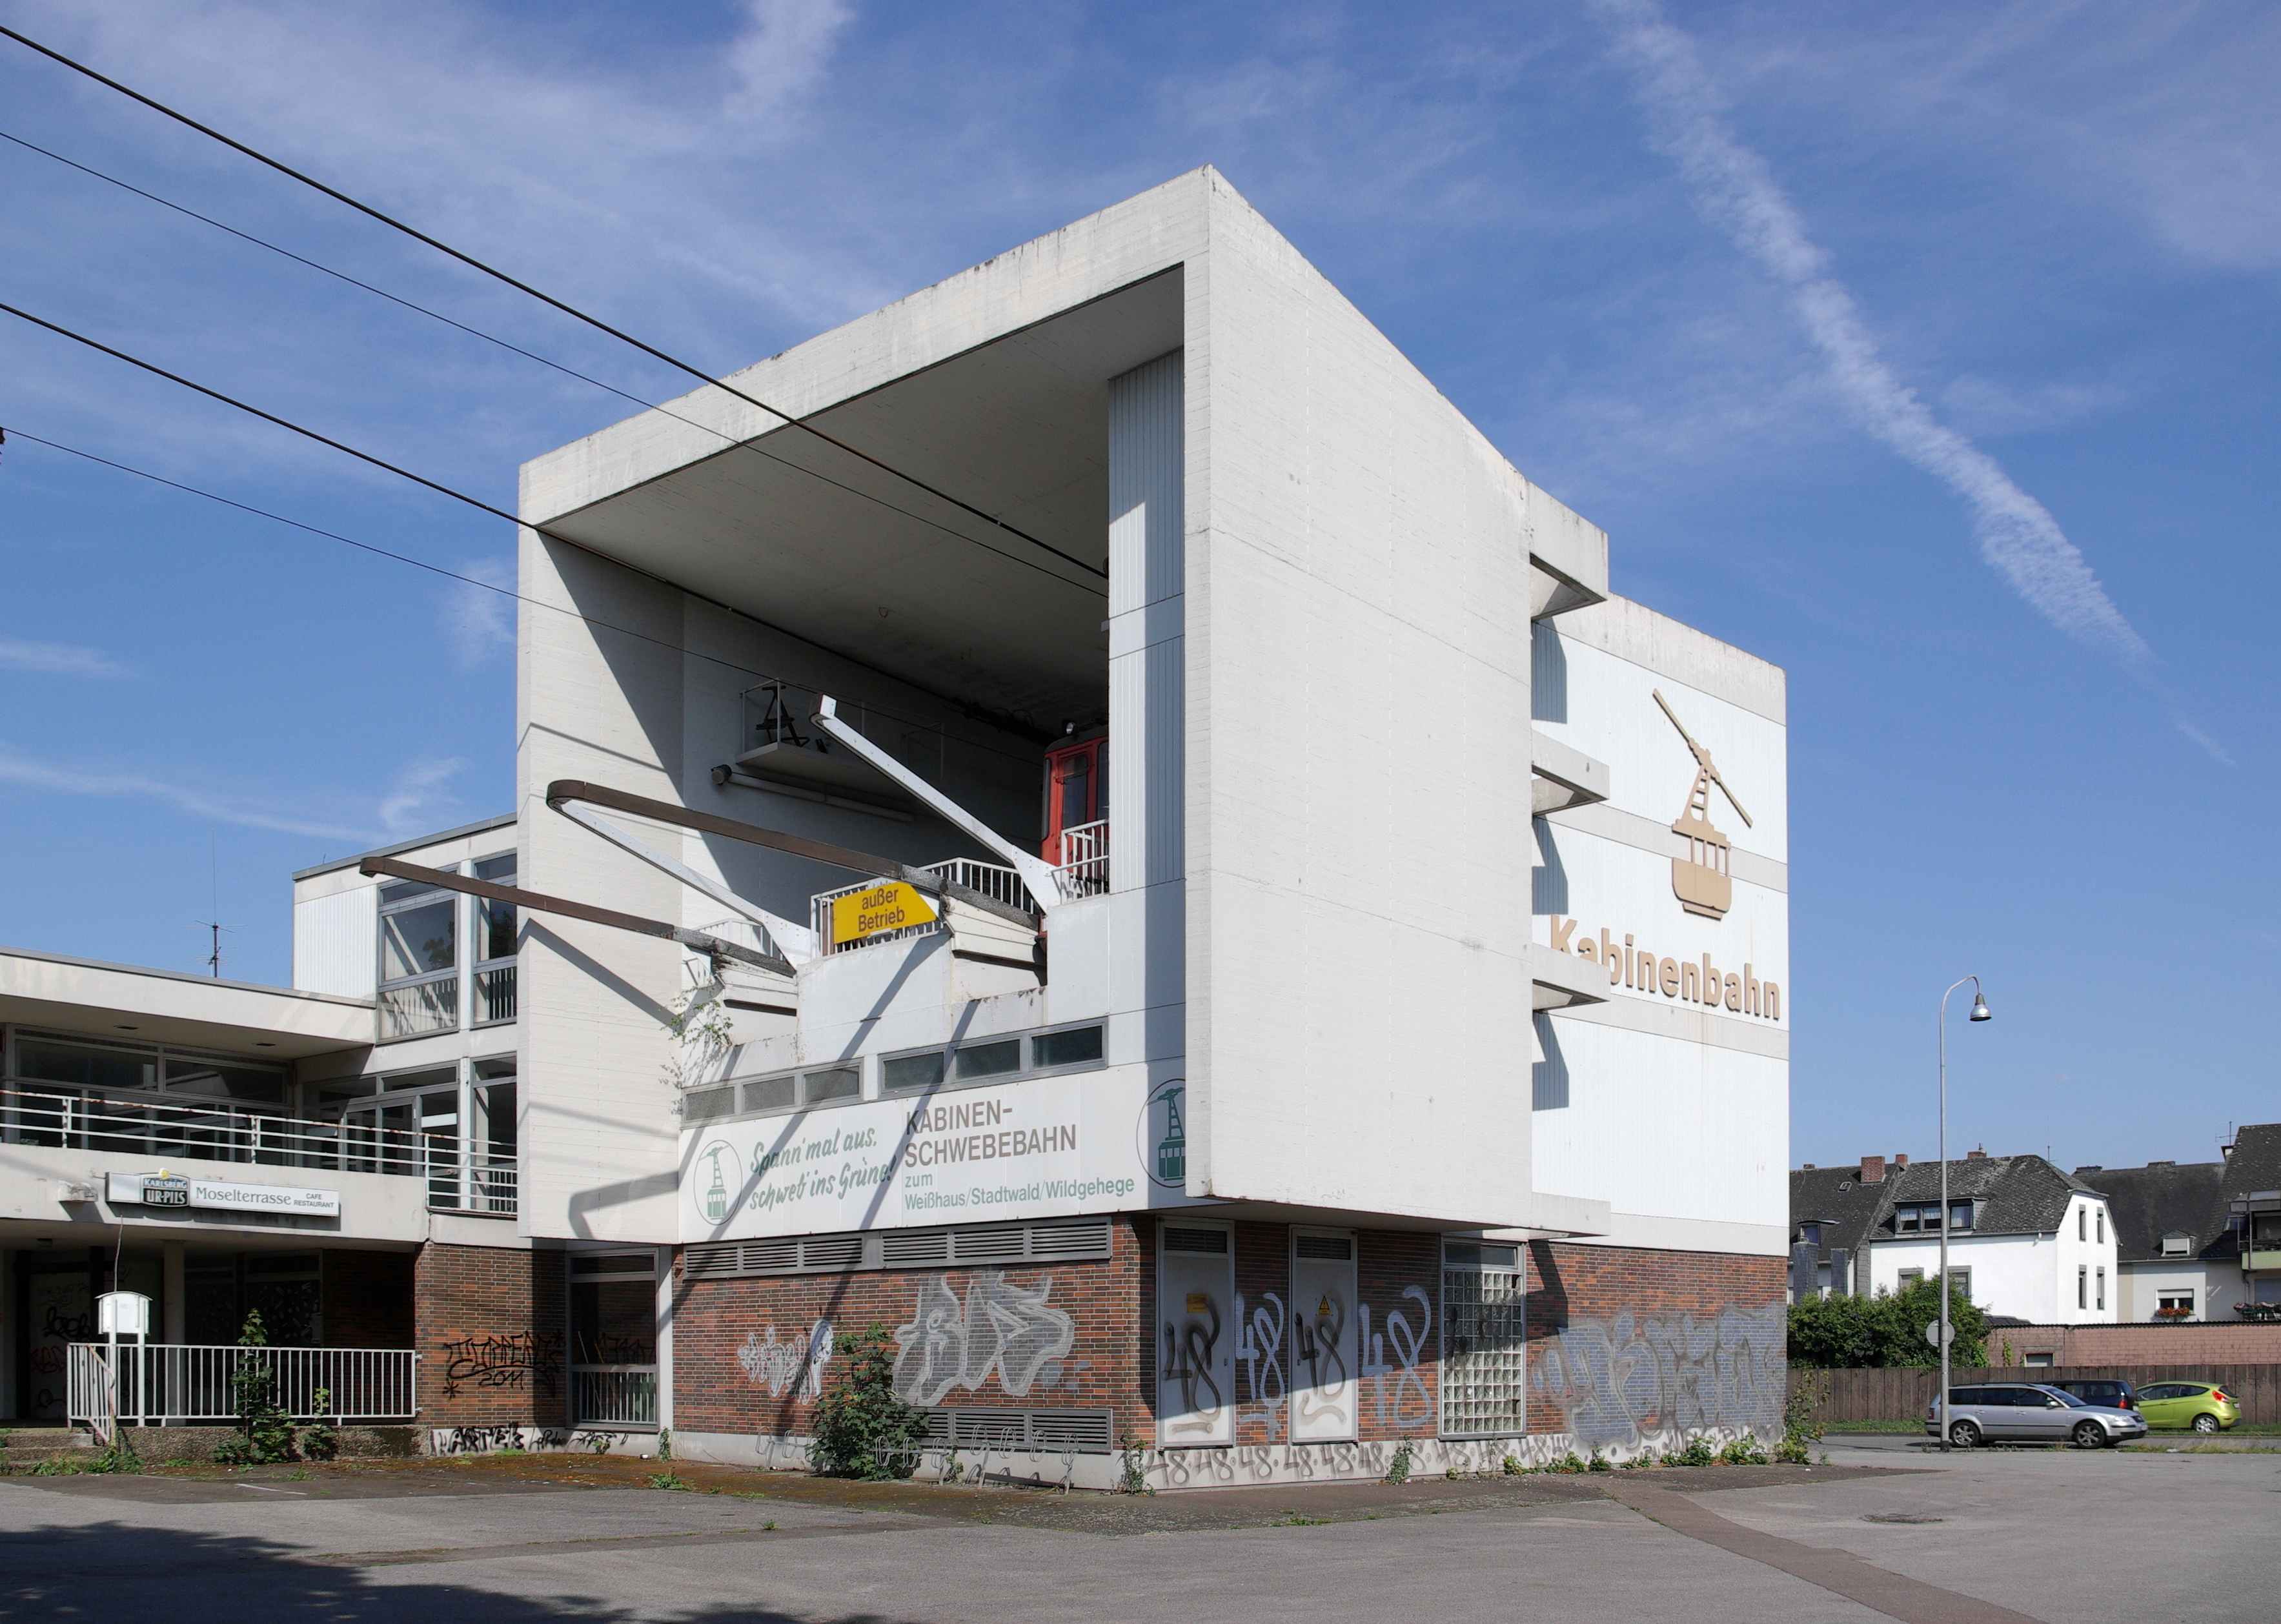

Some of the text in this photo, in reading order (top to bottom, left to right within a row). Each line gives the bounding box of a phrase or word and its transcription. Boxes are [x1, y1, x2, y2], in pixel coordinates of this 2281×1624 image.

[862, 888, 899, 910] außer
[858, 906, 905, 932] Betrieb
[1551, 914, 1780, 1020] Kabinenbahn
[906, 1099, 1013, 1135] KABINEN-
[905, 1124, 1077, 1168] SCHWEBEBAHN
[143, 1177, 188, 1189] KARLSBERG
[809, 1169, 836, 1197] ins
[905, 1173, 933, 1188] zum
[196, 1186, 292, 1205] Moselterrasse
[294, 1199, 335, 1209] RESTAURANT
[1235, 1292, 1285, 1408] 48
[1295, 1290, 1346, 1402] 48
[1358, 1285, 1432, 1426] 48
